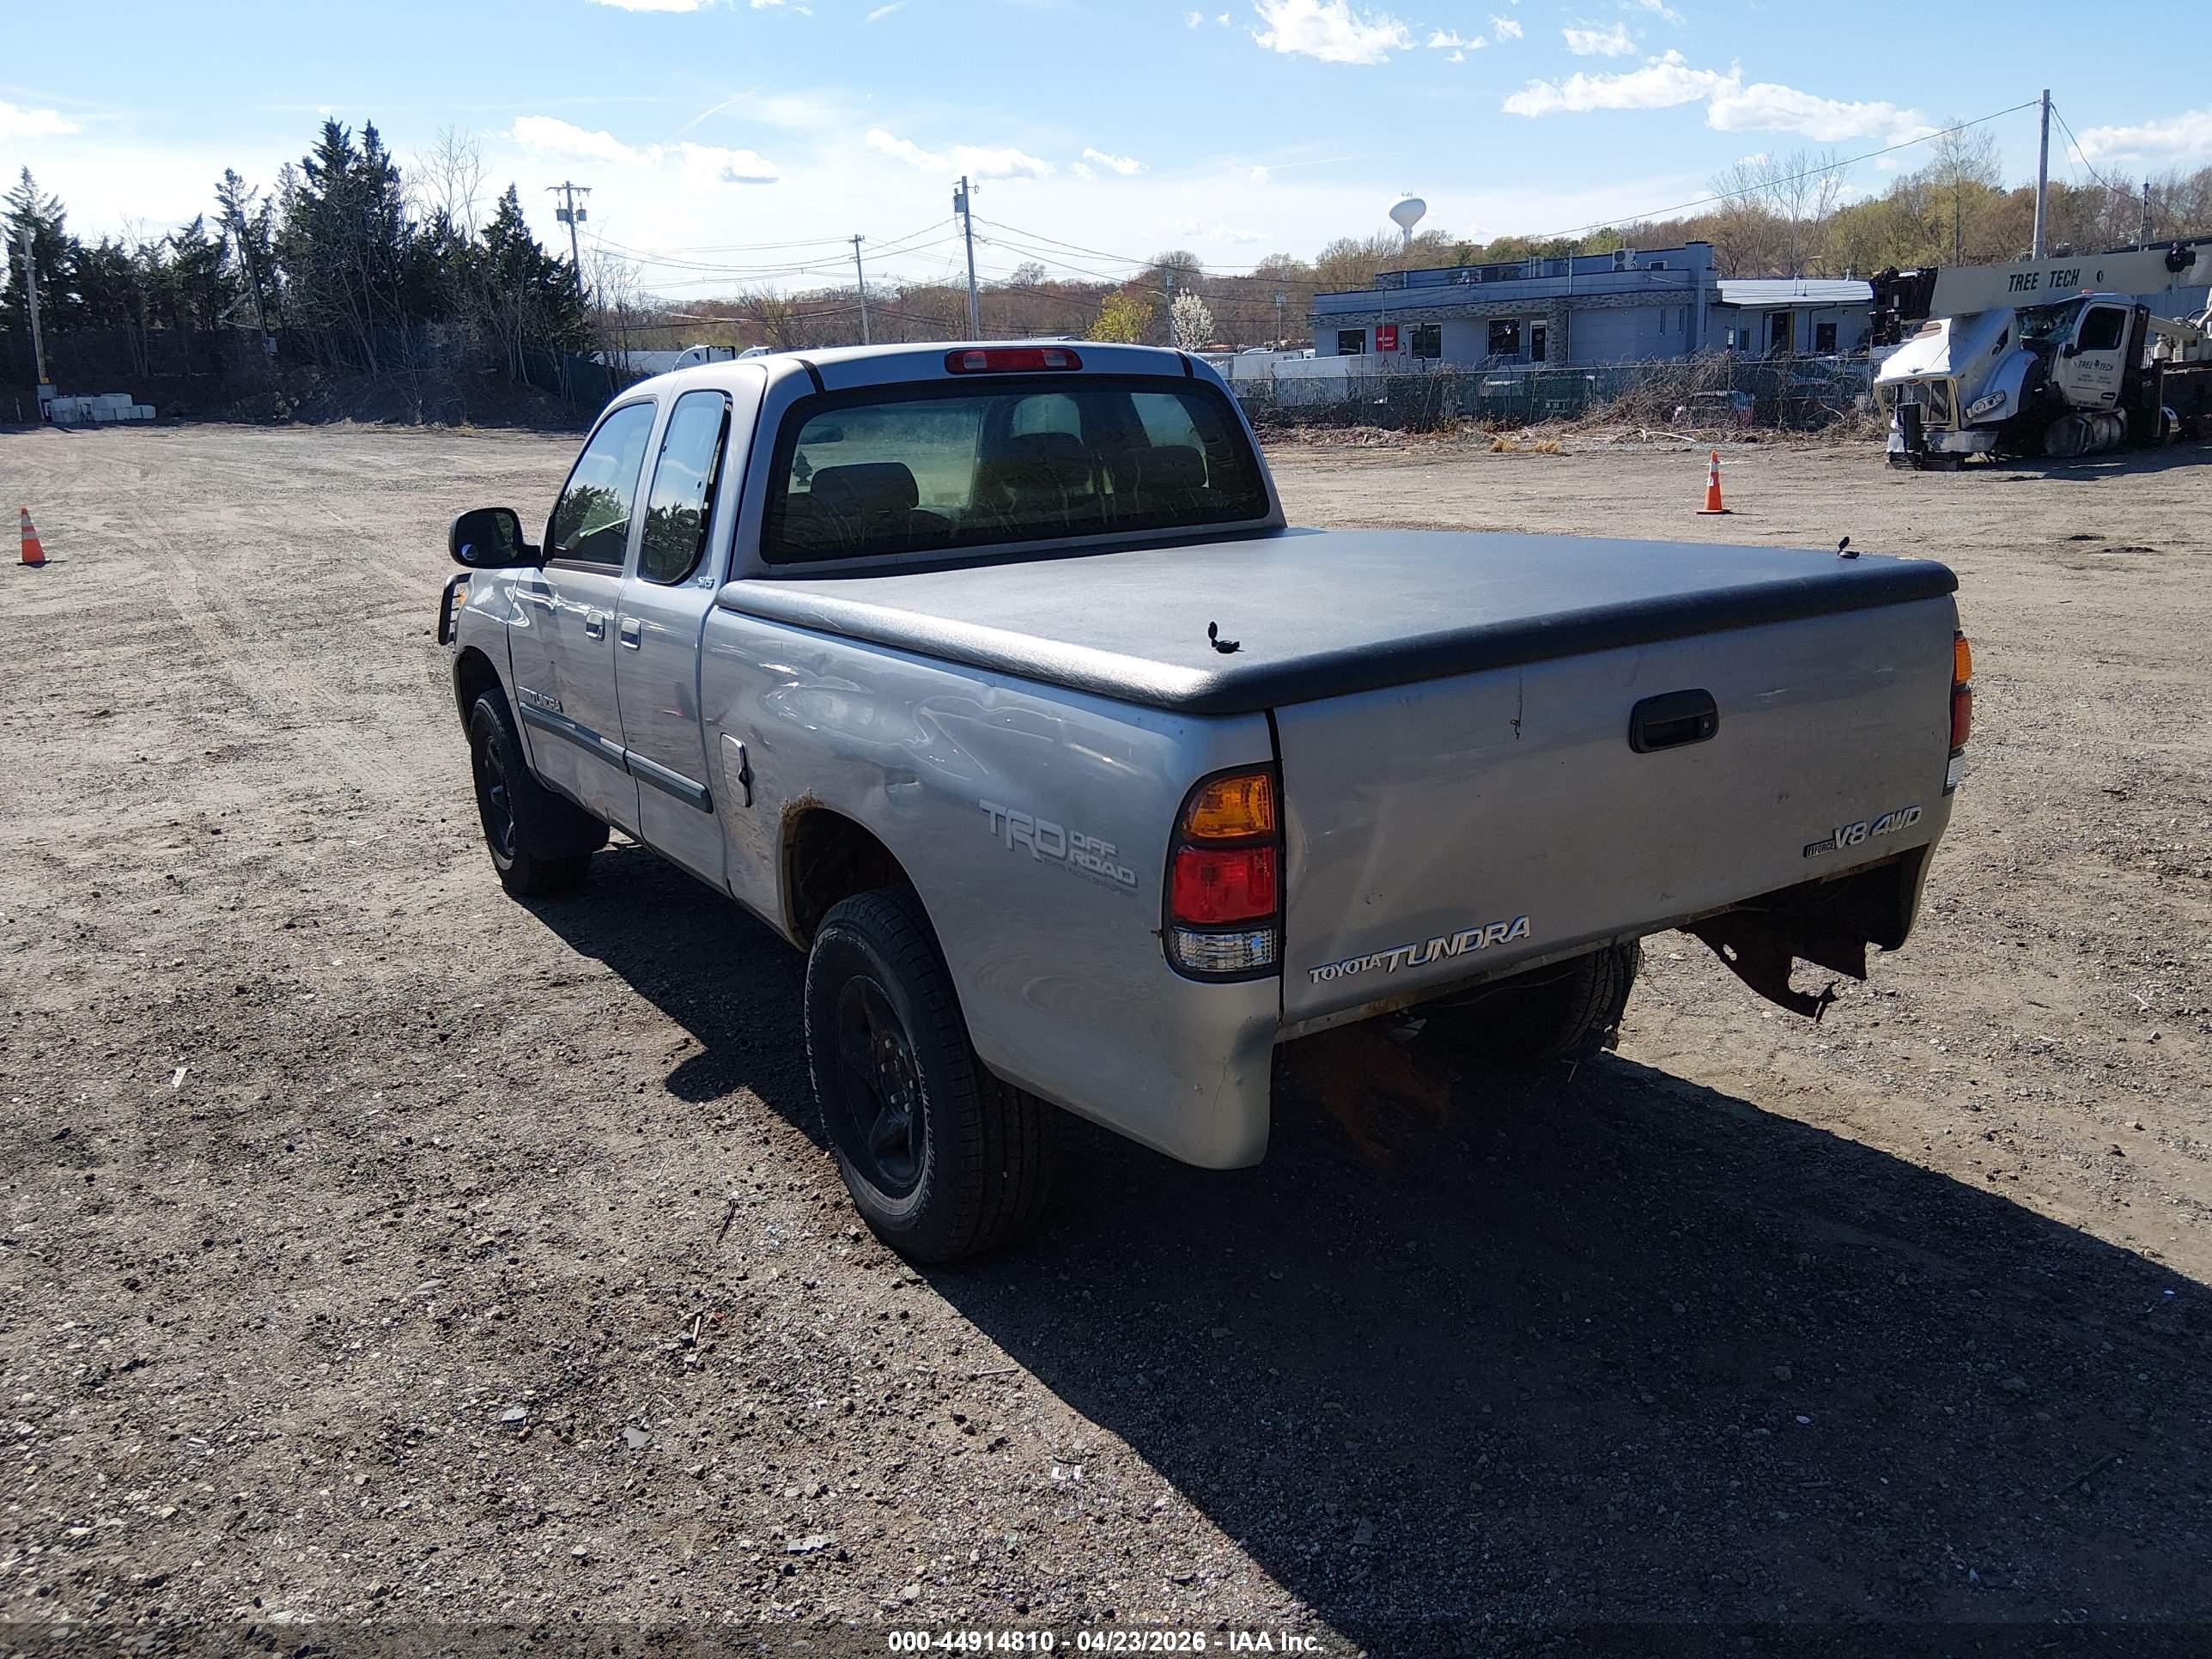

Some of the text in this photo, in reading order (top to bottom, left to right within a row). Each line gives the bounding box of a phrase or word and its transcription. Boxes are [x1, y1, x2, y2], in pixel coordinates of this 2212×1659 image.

[2008, 269, 2081, 292] TREE TECH
[2078, 360, 2094, 369] TREE
[978, 798, 1068, 862] TRD
[1070, 830, 1119, 858] OFF
[1833, 820, 1868, 849] V8
[1869, 805, 1923, 836] 4WD
[1069, 848, 1139, 888] ROAD
[1309, 915, 1530, 984] TOYOTA TUNDRA
